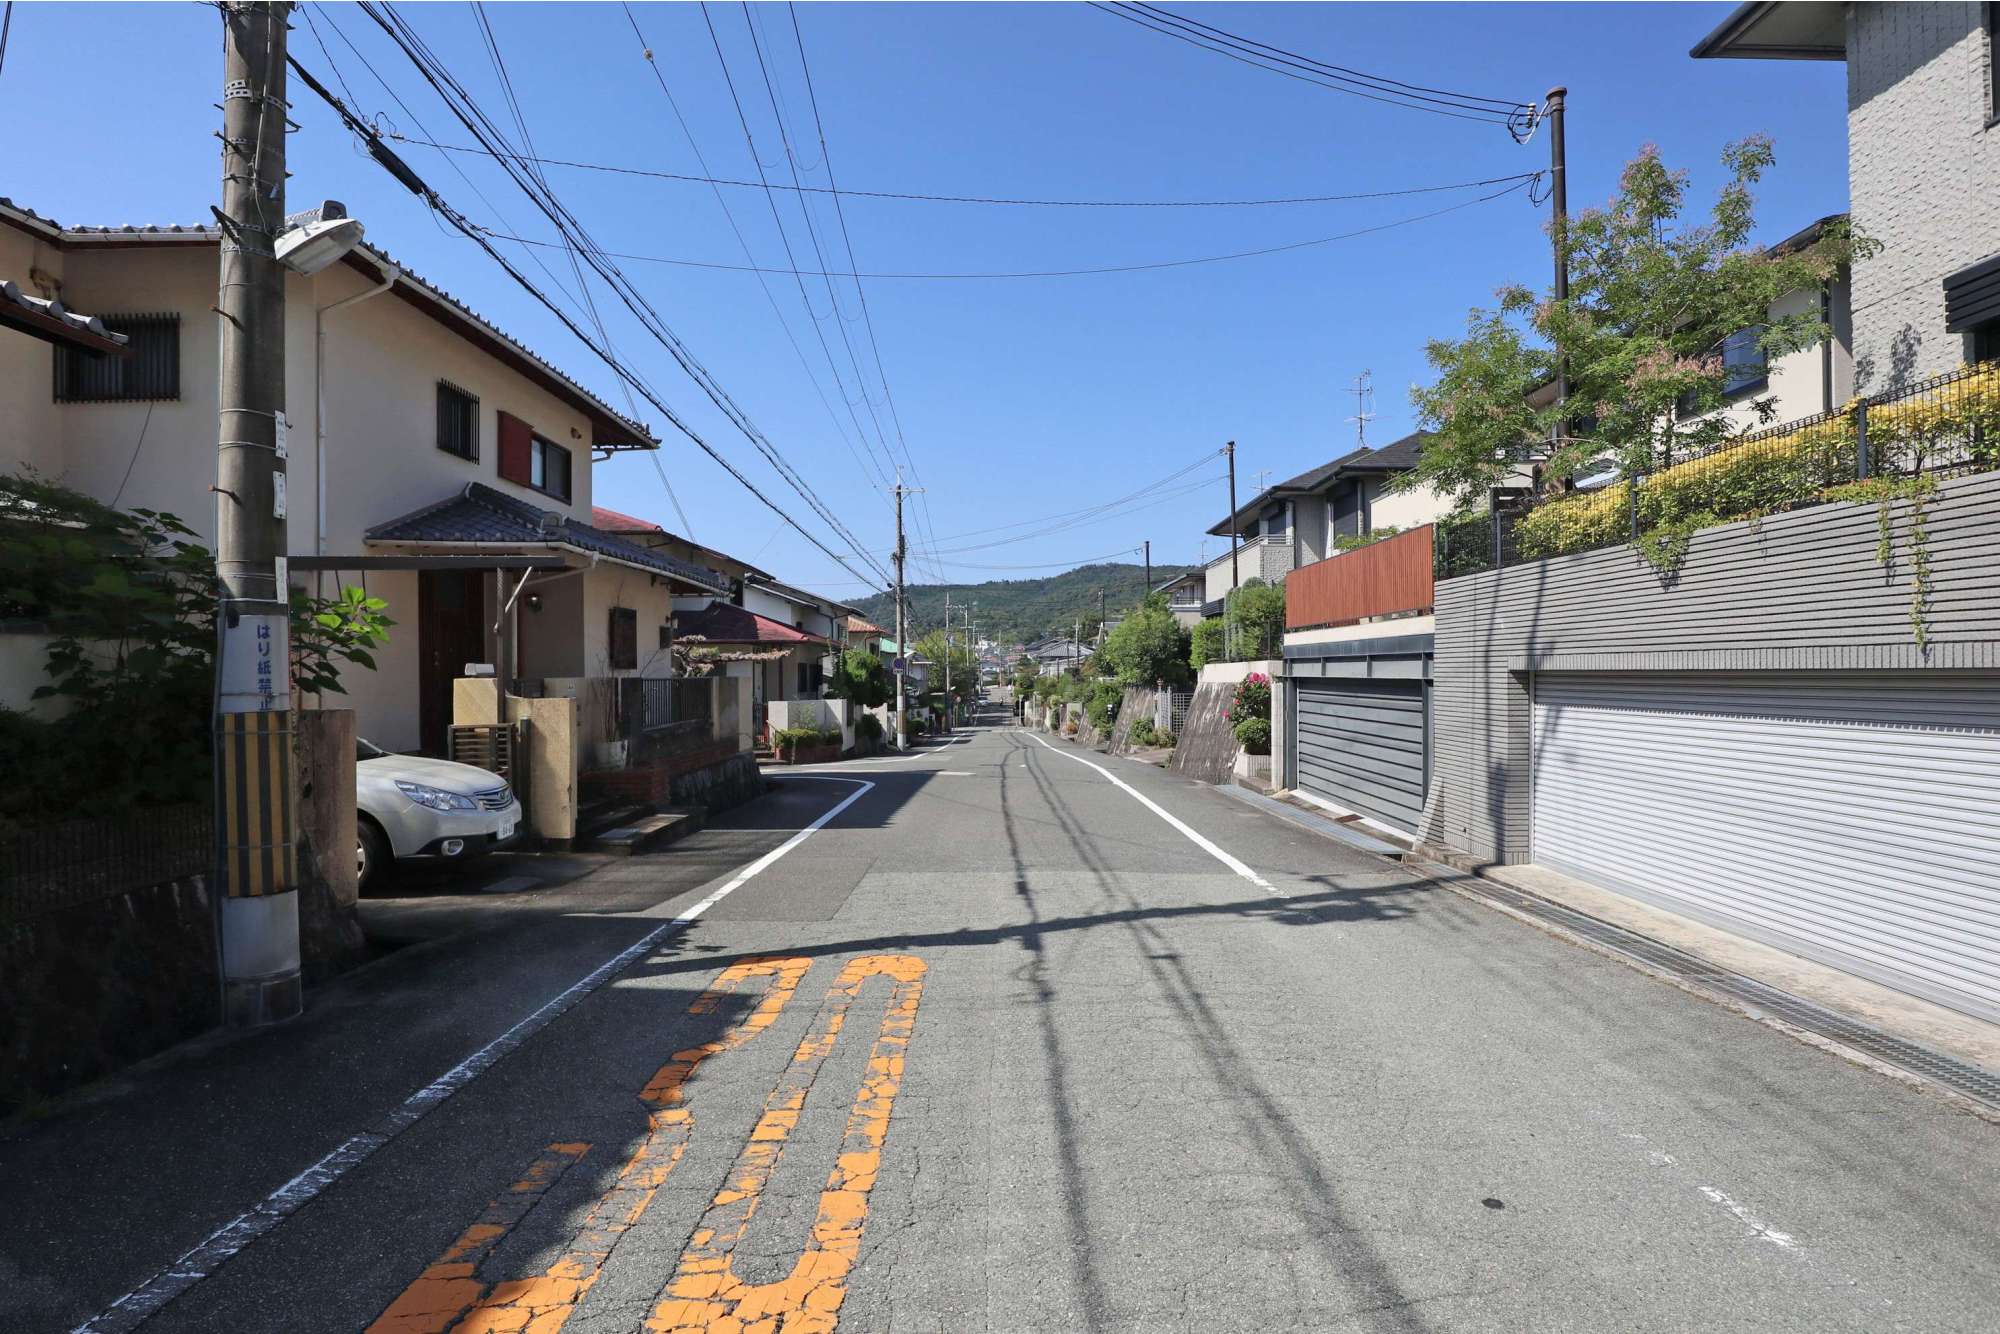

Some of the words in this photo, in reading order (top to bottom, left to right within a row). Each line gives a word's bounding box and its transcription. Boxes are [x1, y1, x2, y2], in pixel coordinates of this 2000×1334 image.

[257, 624, 272, 711] はり紙禁止
[363, 955, 926, 1334] 30
